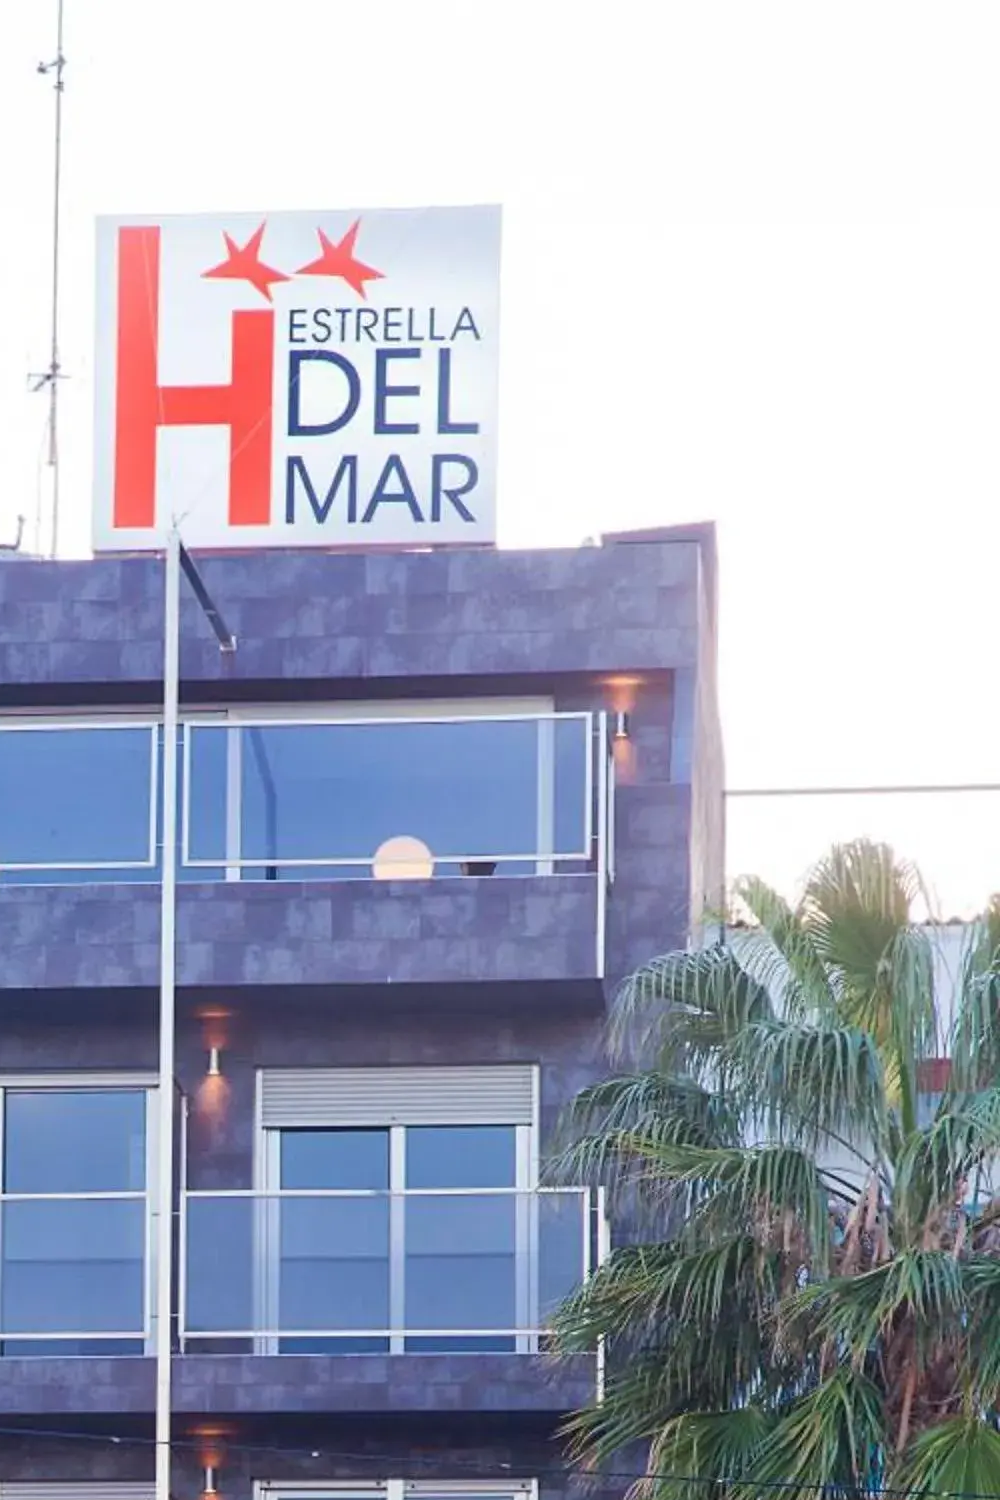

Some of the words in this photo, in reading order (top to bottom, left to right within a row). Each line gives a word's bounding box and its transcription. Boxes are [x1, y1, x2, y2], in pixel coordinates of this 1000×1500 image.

[288, 306, 481, 343] ESTRELLA
[113, 226, 275, 528] H
[287, 347, 480, 437] DEL
[285, 453, 479, 525] MAR
